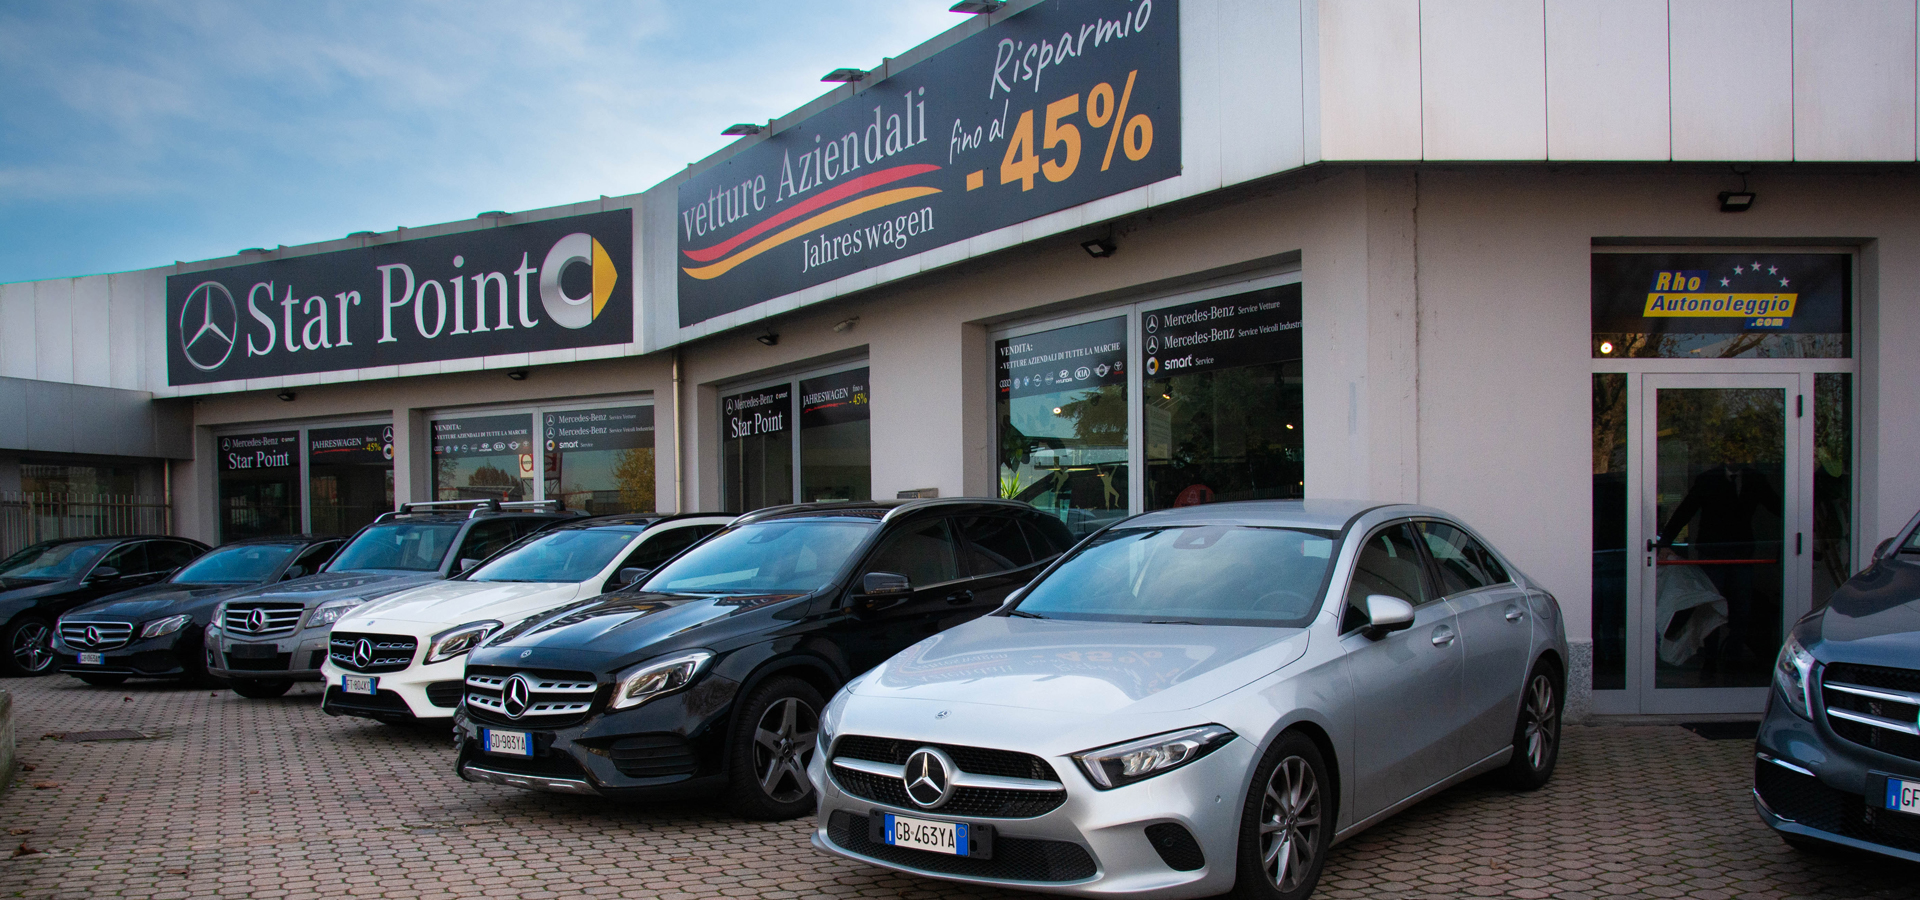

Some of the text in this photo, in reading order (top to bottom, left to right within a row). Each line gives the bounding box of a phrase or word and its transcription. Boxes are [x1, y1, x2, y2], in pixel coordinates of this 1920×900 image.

[989, 0, 1152, 100] Risparmio
[949, 100, 1010, 165] fino al
[682, 86, 928, 242] vetture Aziendali
[1655, 271, 1701, 291] Rho
[247, 251, 539, 357] Star Point
[1650, 295, 1790, 316] Autonoleggio
[1164, 301, 1281, 328] Mercedes-Benz Service Vetture
[1751, 317, 1784, 327] .com
[1164, 328, 1235, 349] Mercedes-Benz
[1238, 327, 1258, 338] Service
[1258, 324, 1279, 335] Veicoli
[1000, 343, 1033, 357] VENDITA:
[1028, 353, 1057, 366] AZIENDALI
[1058, 352, 1064, 360] DI
[1064, 348, 1084, 359] TUTTE
[1084, 347, 1093, 356] LA
[1094, 342, 1120, 353] MARCHE
[1164, 354, 1214, 370] smart Service
[1077, 368, 1088, 379] KIA
[734, 393, 773, 411] Mercedes-Benz
[802, 386, 849, 409] JAHRESWAGEN
[434, 424, 462, 432] VENDITA:
[558, 413, 607, 424] Mercedes-Benz
[731, 410, 783, 439] Star Point
[558, 426, 608, 437] Mercedes-Benz
[232, 436, 279, 449] Mercedes-Benz
[312, 437, 362, 451] JAHRESWAGEN
[559, 440, 579, 449] smart
[228, 450, 290, 470] Star Point
